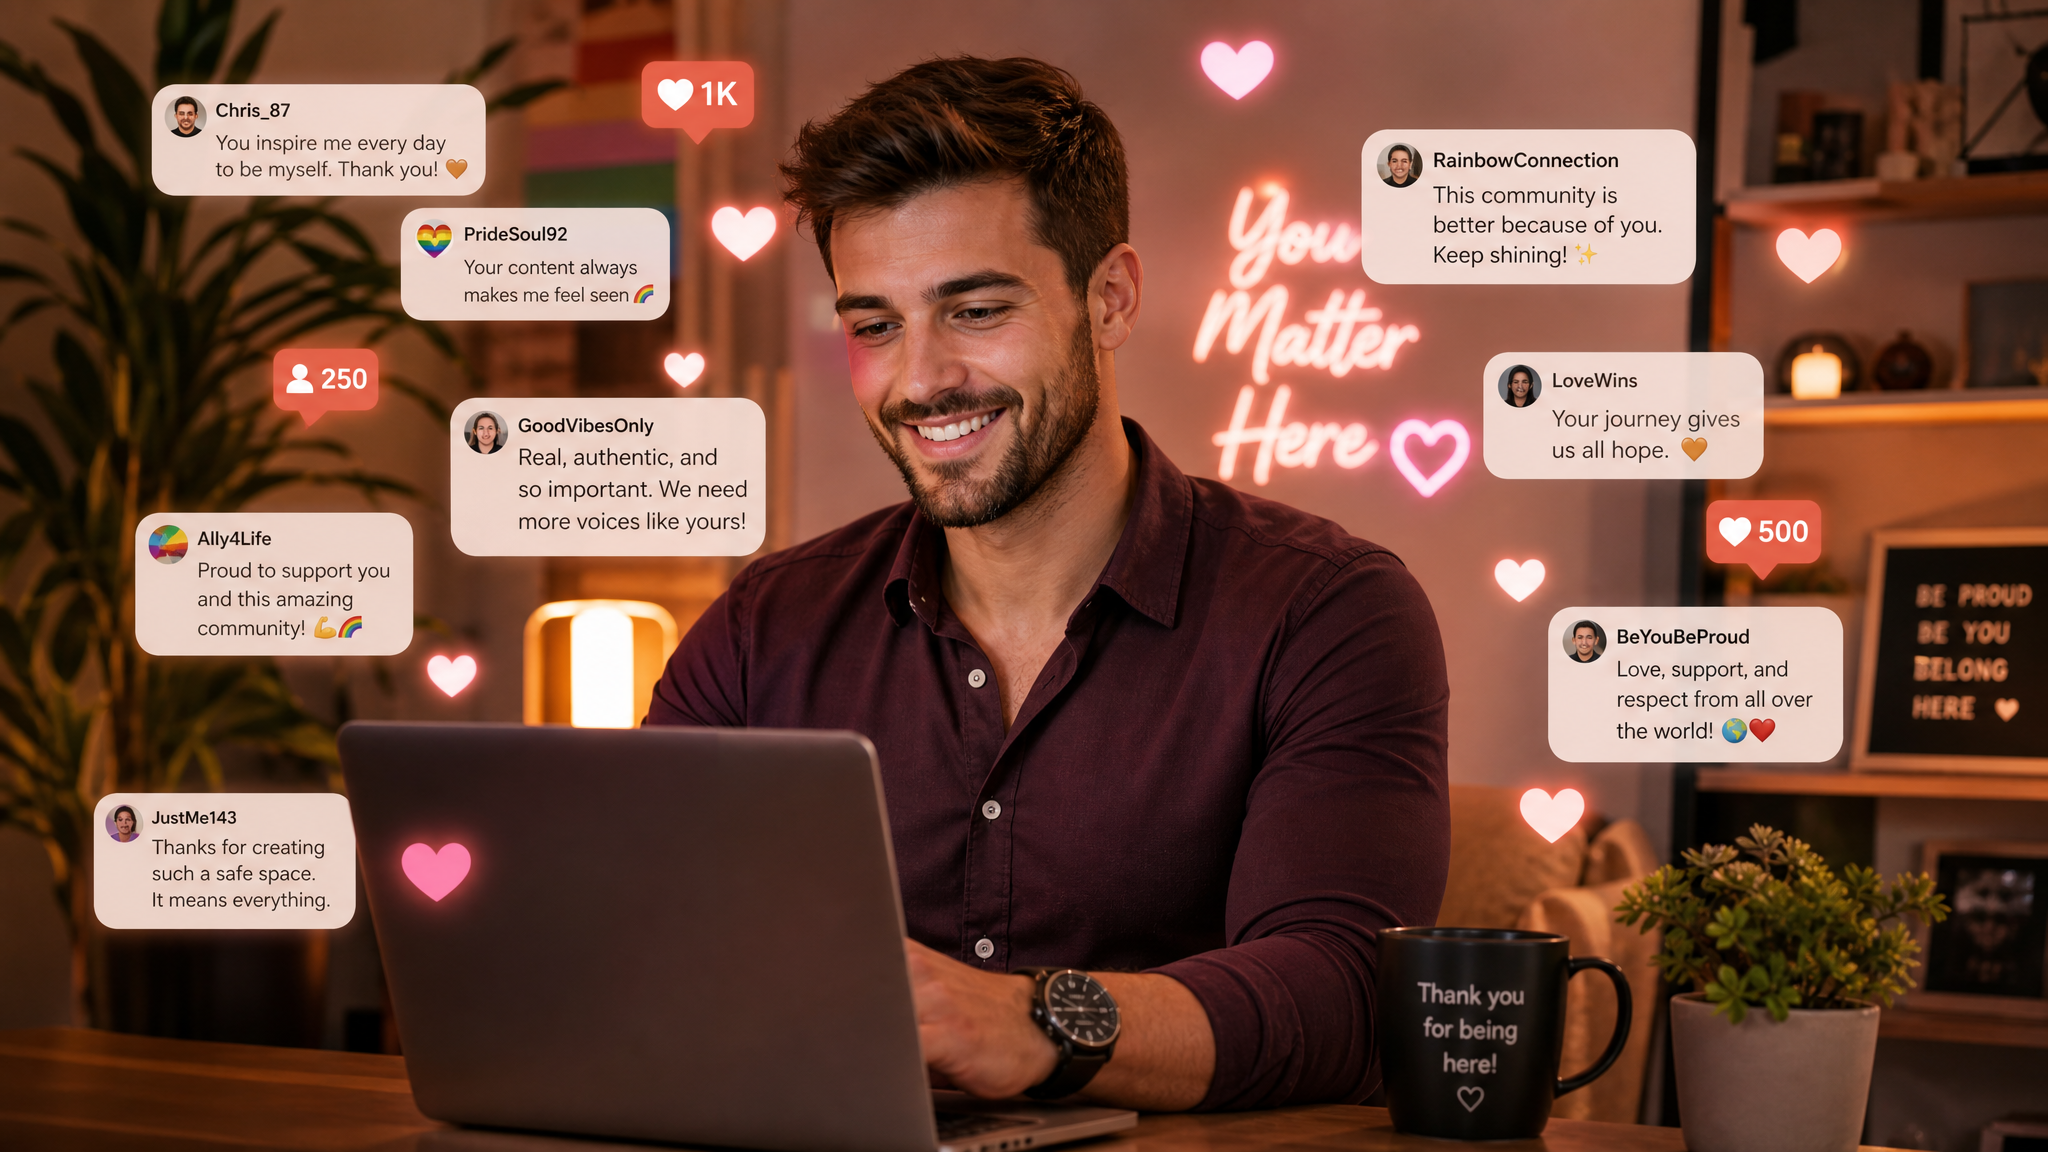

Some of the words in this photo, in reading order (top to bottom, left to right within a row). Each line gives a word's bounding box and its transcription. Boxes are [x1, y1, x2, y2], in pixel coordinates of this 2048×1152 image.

[1228, 185, 1362, 290] You
[1193, 284, 1421, 385] Matter
[1211, 384, 1380, 486] Here
[1915, 583, 1945, 608] BE
[1957, 583, 2033, 608] PROUD
[1917, 620, 1949, 645] BE
[1962, 620, 2011, 645] YOU
[1913, 655, 2009, 682] BELONG
[1912, 695, 1976, 721] HERE
[1416, 981, 1482, 1006] Thank
[1487, 990, 1525, 1012] you
[1422, 1015, 1455, 1039] for
[1459, 1017, 1518, 1046] being
[1443, 1051, 1497, 1075] here!
